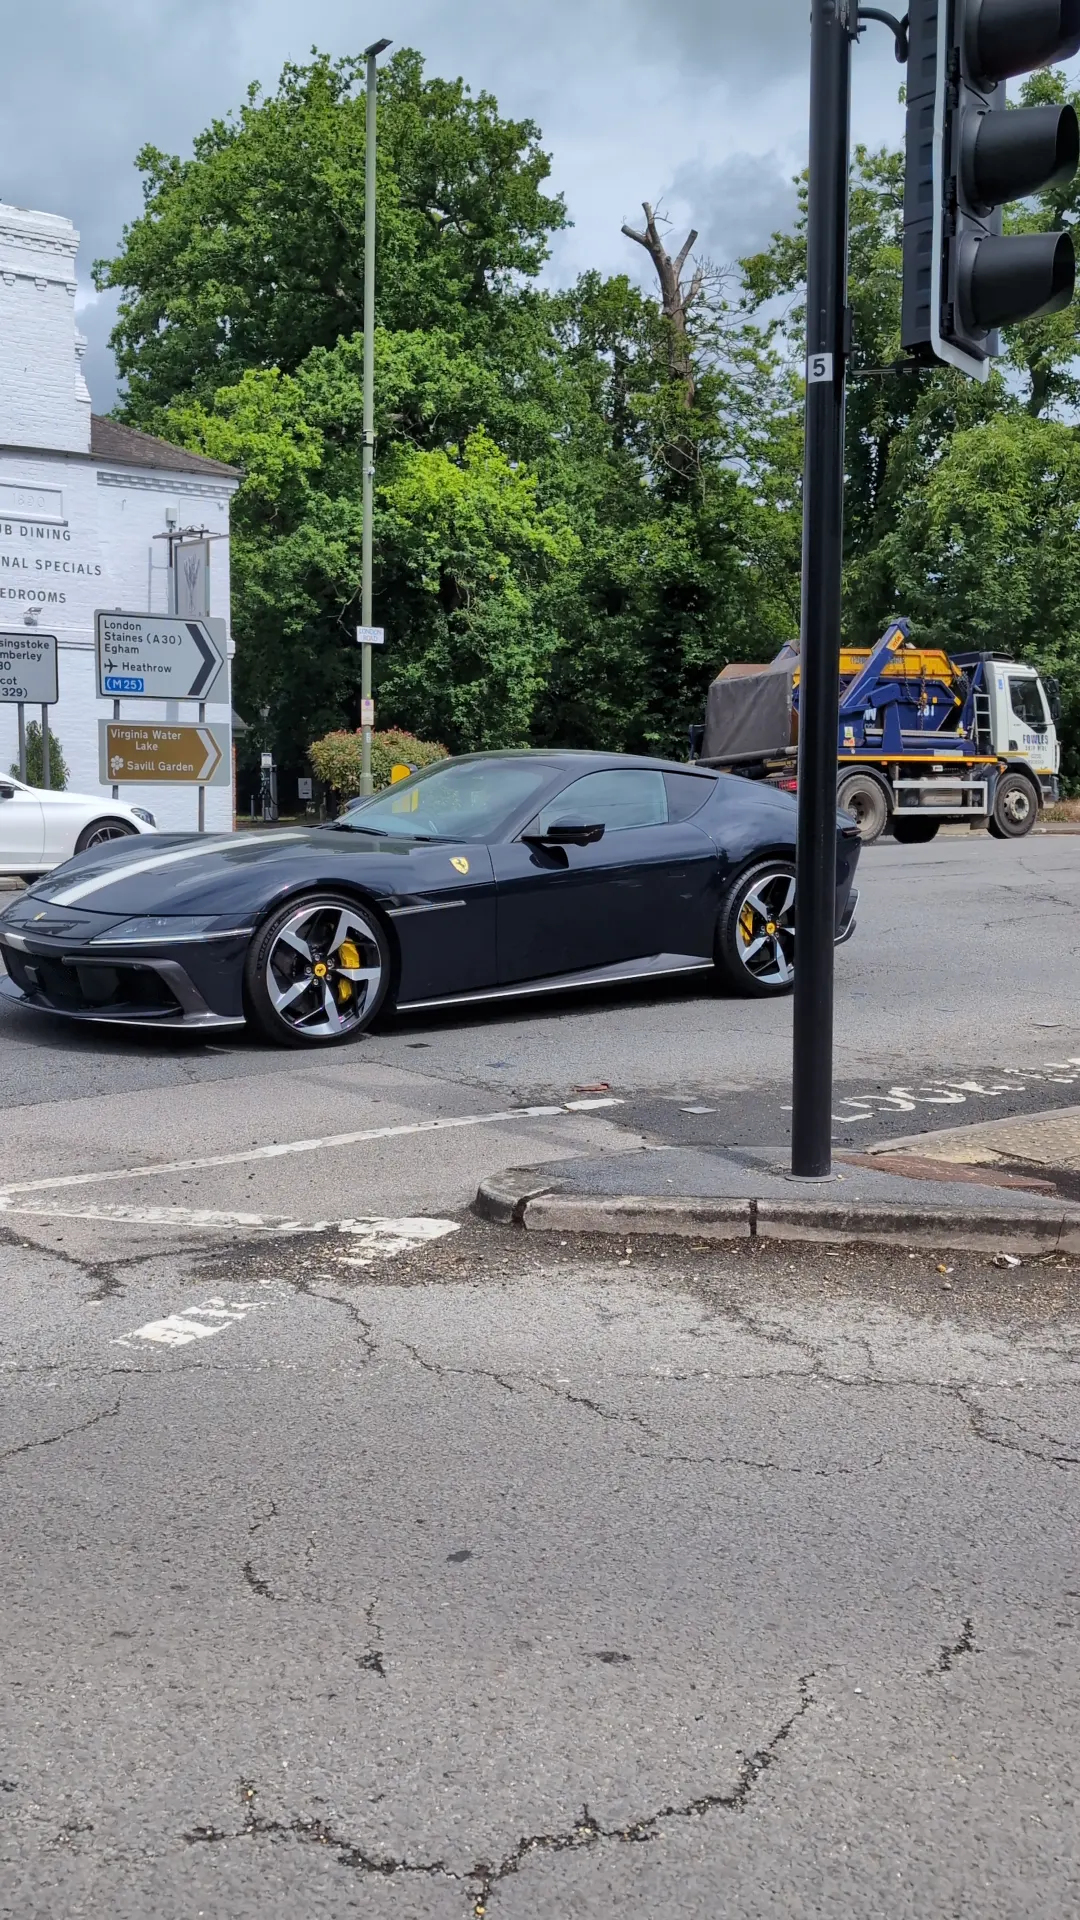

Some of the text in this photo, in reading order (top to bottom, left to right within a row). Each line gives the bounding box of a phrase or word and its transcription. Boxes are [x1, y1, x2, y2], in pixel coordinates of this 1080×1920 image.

[813, 358, 825, 377] 5
[20, 526, 71, 541] DINING
[1, 556, 102, 576] NAL SPECIALS
[0, 588, 66, 603] EDROOMS
[104, 620, 141, 630] London
[104, 631, 182, 645] Staines (A30)
[0, 639, 49, 650] singstoke
[104, 643, 139, 654] Egham
[122, 661, 172, 673] Heathrow
[0, 676, 17, 685] cot
[106, 678, 143, 691] (M25)
[111, 729, 182, 740] Virginia Water
[1023, 734, 1048, 744] FOWLES
[135, 741, 159, 751] Lake
[127, 760, 194, 771] Savill Garden
